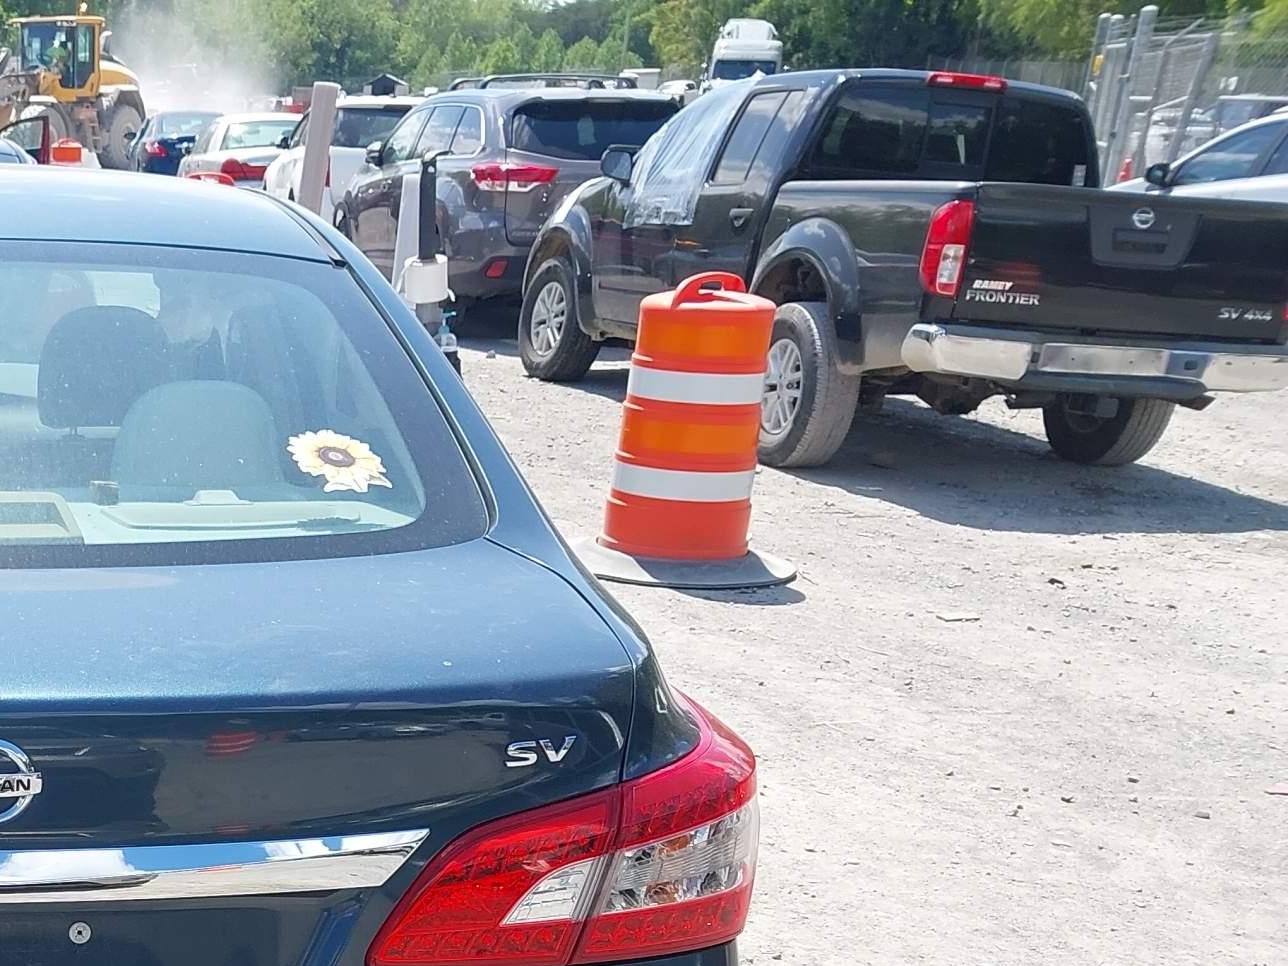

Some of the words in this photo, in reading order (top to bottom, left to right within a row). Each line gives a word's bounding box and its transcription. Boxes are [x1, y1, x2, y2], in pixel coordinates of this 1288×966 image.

[965, 289, 1040, 306] FRONTIER
[1217, 307, 1242, 320] SV
[504, 735, 577, 768] SV
